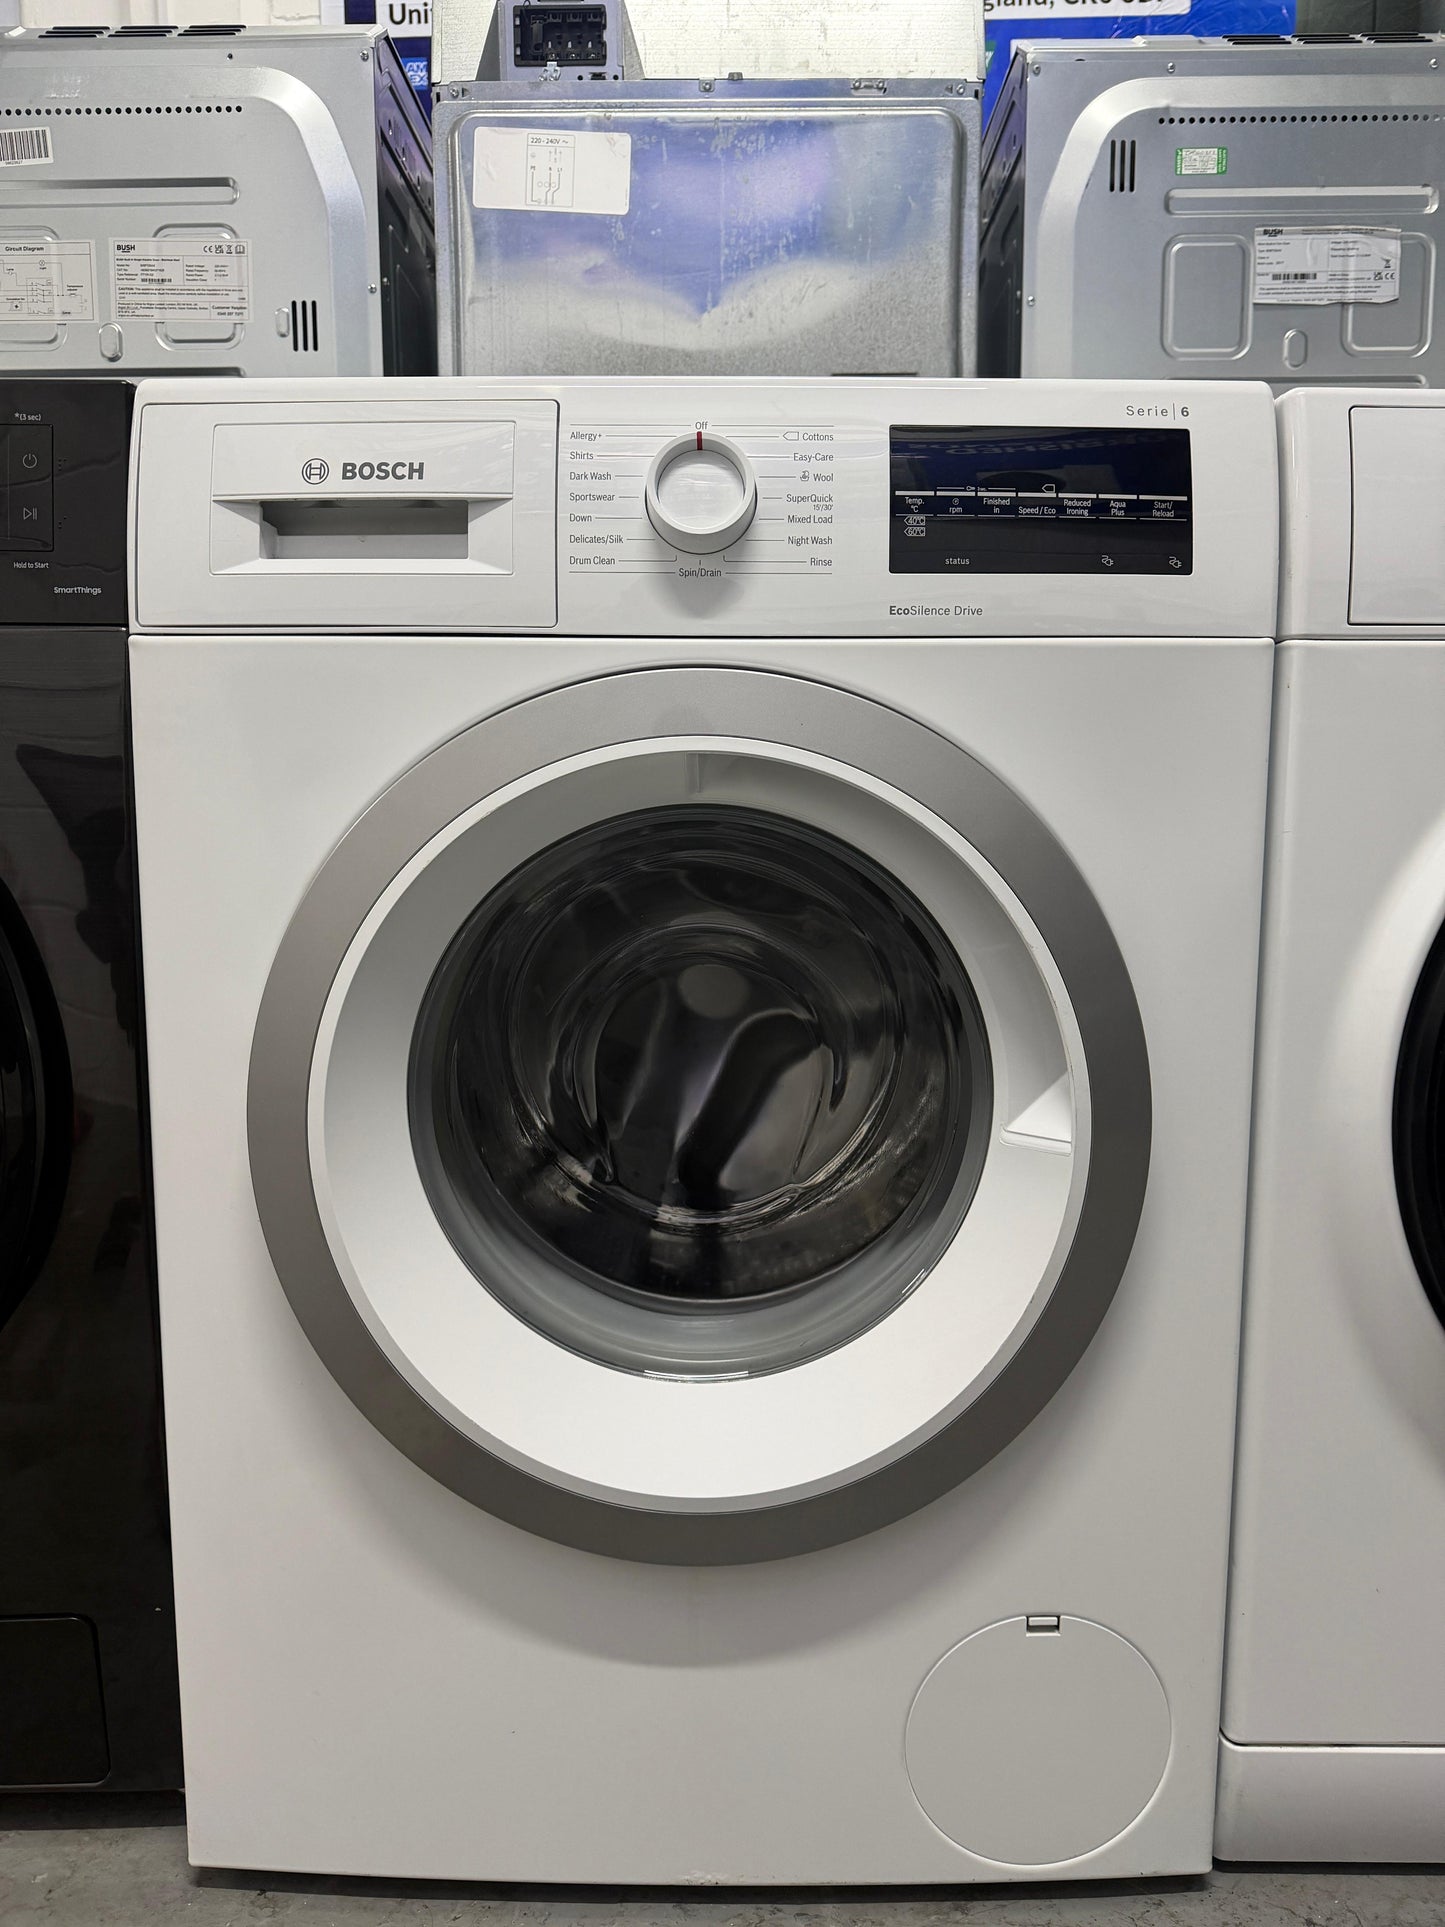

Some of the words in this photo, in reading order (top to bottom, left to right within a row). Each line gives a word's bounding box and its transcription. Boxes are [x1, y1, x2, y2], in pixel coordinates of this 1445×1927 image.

[389, 2, 432, 25] Uni
[1263, 228, 1283, 237] BUSH
[1126, 405, 1168, 417] Serie
[1181, 406, 1189, 417] 6
[28, 413, 41, 421] sec)
[695, 421, 708, 430] Off
[802, 432, 834, 441] Cottons
[569, 451, 594, 460] Shirts
[793, 452, 834, 463] Easy-Care
[341, 461, 425, 481] BOSCH
[569, 471, 589, 481] Dark
[590, 471, 612, 481] Wash
[813, 473, 834, 482] Wool
[569, 492, 616, 502] Sportswear
[786, 493, 834, 504] SuperQuick
[904, 496, 925, 506] Temp.
[983, 498, 1011, 506] Finished
[1063, 499, 1092, 507] Reduced
[1109, 500, 1127, 509] Aqua
[1153, 501, 1173, 510] Start/
[993, 506, 1000, 514] in
[1018, 506, 1039, 515] Speed
[1044, 507, 1057, 515] Eco
[1066, 508, 1089, 517] Ironing
[1111, 508, 1125, 516] Plus
[1152, 510, 1175, 518] Reload
[569, 513, 592, 522] Down
[787, 515, 812, 524] Mixed
[813, 515, 833, 524] Load
[569, 535, 624, 545] Delicates/Silk
[787, 536, 809, 547] Night
[811, 536, 833, 545] Wash
[13, 561, 27, 569] Hold
[28, 561, 34, 569] to
[35, 561, 49, 569] Start
[569, 556, 592, 565] Drum
[593, 556, 616, 565] Clean
[810, 557, 833, 566] Rinse
[678, 568, 722, 578] Spin/Drain
[54, 586, 102, 595] SmartThings
[889, 605, 951, 616] EcoSilence
[954, 605, 983, 616] Drive
